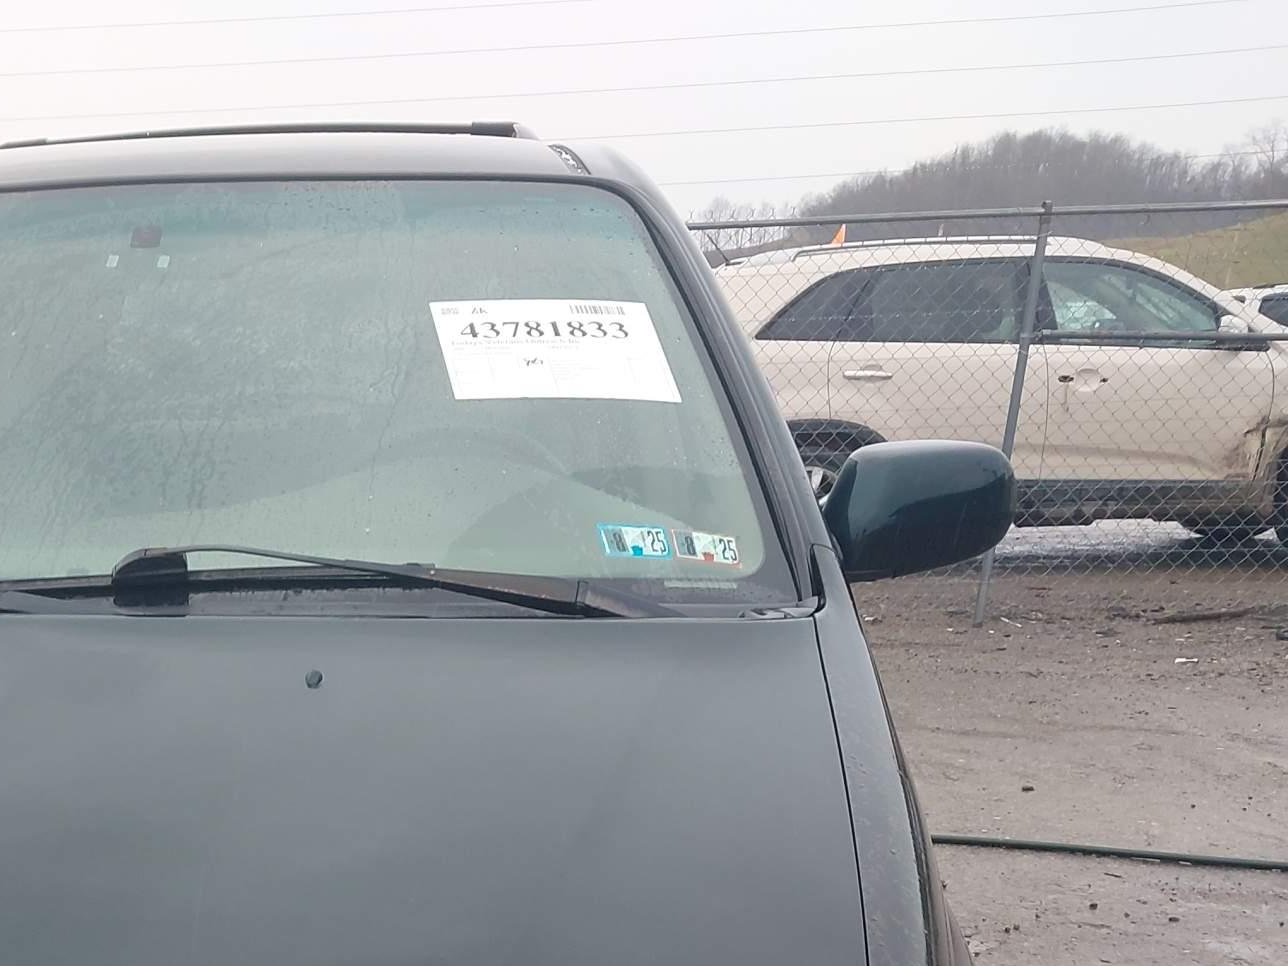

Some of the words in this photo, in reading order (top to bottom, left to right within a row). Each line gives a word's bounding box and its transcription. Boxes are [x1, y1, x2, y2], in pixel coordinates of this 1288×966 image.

[460, 320, 629, 339] 43781833
[647, 531, 667, 553] 25
[719, 538, 738, 561] 25
